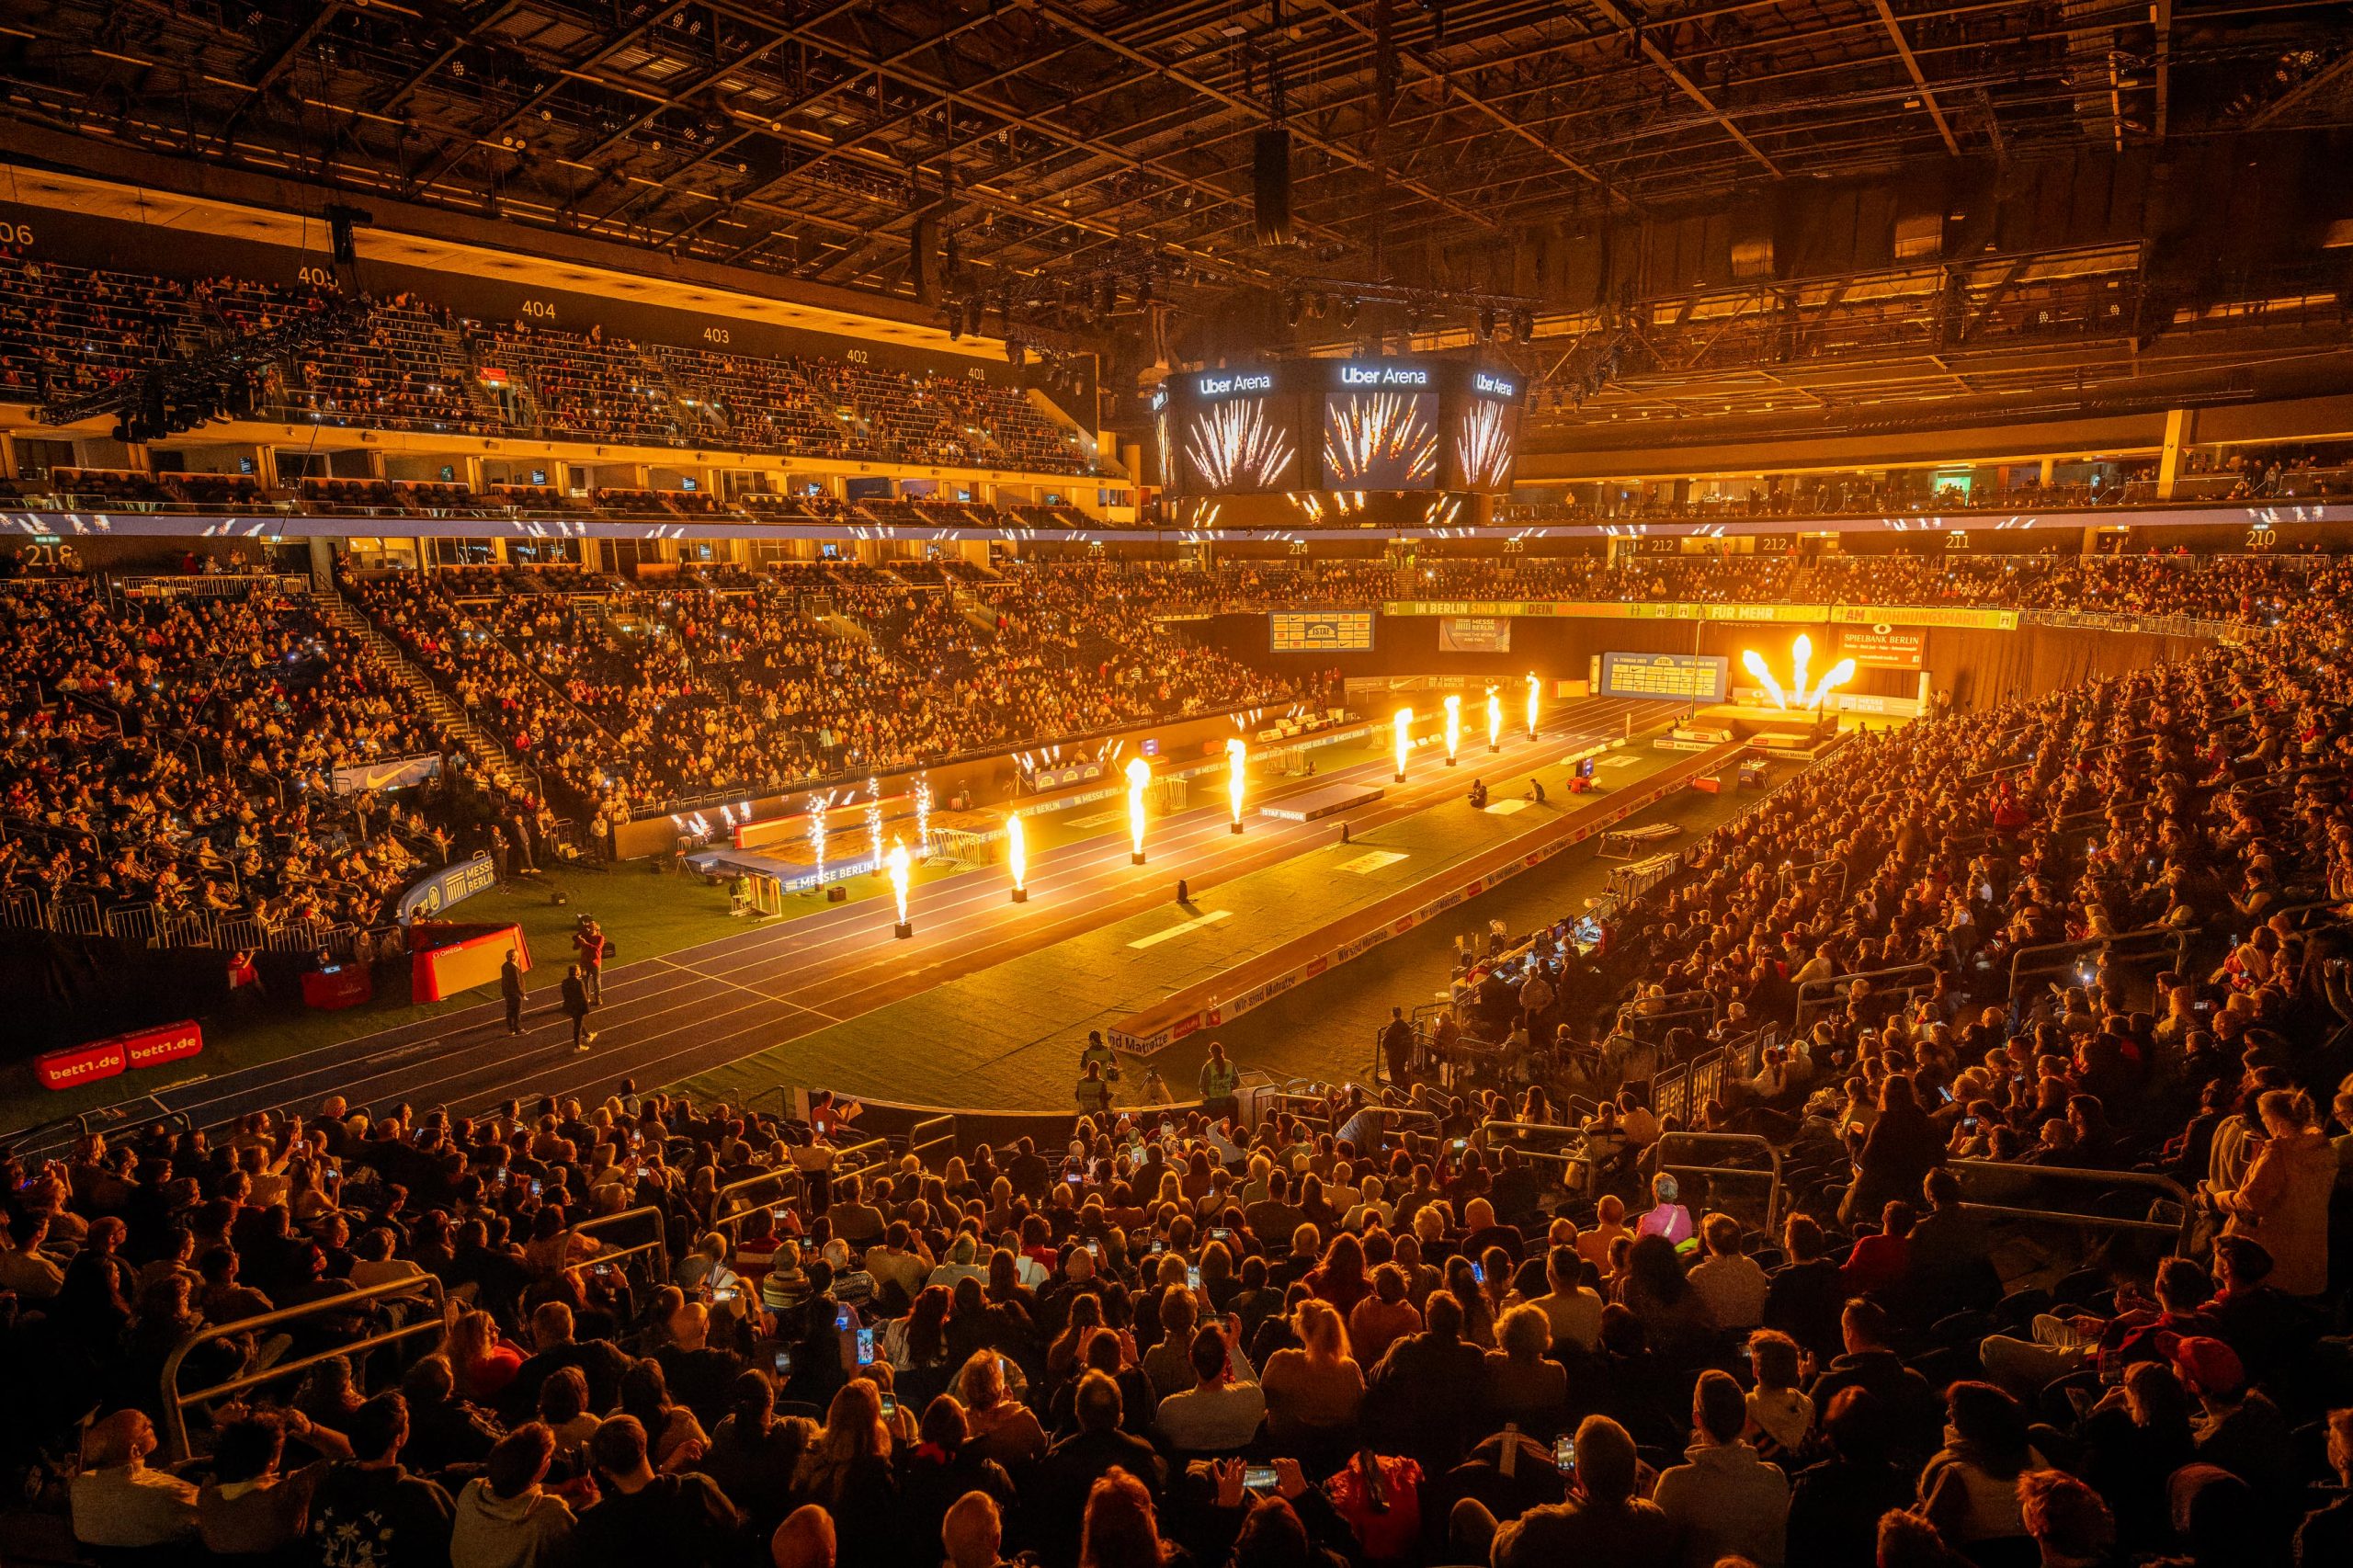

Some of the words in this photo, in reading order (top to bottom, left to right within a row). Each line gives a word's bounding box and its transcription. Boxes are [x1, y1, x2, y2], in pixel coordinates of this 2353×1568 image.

[522, 301, 556, 319] 404
[703, 327, 730, 345] 403
[847, 349, 869, 364] 402
[968, 368, 985, 381] 401
[1342, 367, 1381, 383] Uber
[1382, 367, 1427, 383] Arena
[1200, 379, 1232, 394] Uber
[1233, 375, 1271, 392] Arena
[1477, 373, 1495, 392] Uber
[1493, 378, 1512, 396] Arena
[1762, 538, 1788, 551] 212
[1945, 535, 1970, 549] 211
[2245, 529, 2276, 547] 210
[1087, 545, 1106, 557] 215
[1289, 543, 1309, 555] 214
[1503, 541, 1524, 553] 213
[1651, 540, 1674, 552] 212
[1415, 603, 1427, 614] IN
[1429, 603, 1468, 614] BERLIN
[1471, 603, 1496, 615] SIND
[1499, 603, 1522, 615] WIR
[1528, 604, 1553, 615] DEIN
[1711, 604, 1735, 619] FÜR
[1739, 607, 1774, 619] MEHR
[1846, 609, 1865, 621] AM
[1870, 609, 1986, 626] WOHNUNGSMARKT
[1844, 633, 1887, 643] SPIELBANK
[1889, 636, 1919, 645] BERLIN
[1082, 791, 1104, 803] MESSE
[1036, 801, 1060, 814] BERLIN
[466, 859, 494, 881] MESSE
[801, 870, 836, 889] MESSE
[839, 860, 874, 879] BERLIN
[440, 946, 463, 957] OMEGA
[1337, 948, 1348, 962] Wir
[1349, 942, 1361, 956] sind
[1360, 929, 1388, 949] Matratze
[1233, 998, 1247, 1013] Wir
[1248, 988, 1265, 1006] sind
[1266, 974, 1296, 998] Matratze
[130, 1038, 196, 1060] bett1.de
[1125, 1033, 1168, 1053] Matratze
[49, 1056, 120, 1081] bett1.de
